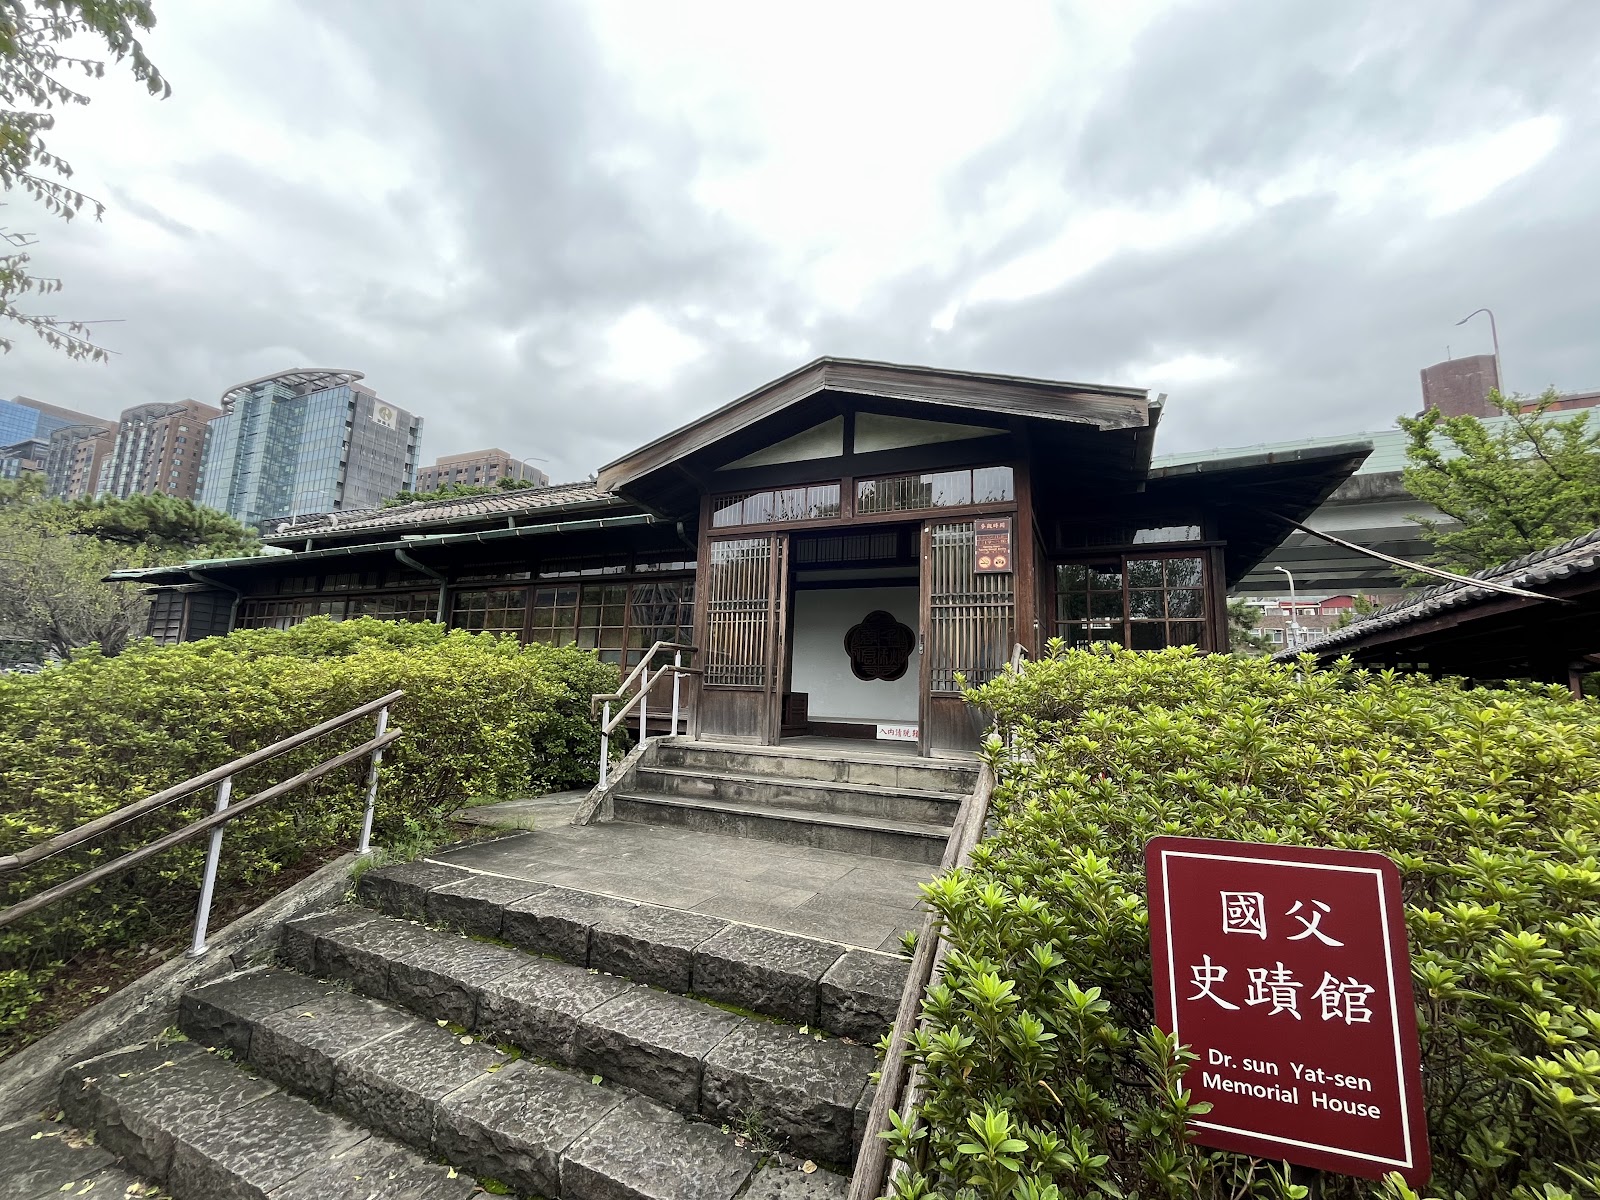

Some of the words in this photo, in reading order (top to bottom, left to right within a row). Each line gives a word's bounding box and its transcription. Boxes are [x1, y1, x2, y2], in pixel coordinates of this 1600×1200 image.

[1219, 890, 1345, 947] 國父
[1186, 953, 1376, 1026] 史蹟館
[1202, 1071, 1299, 1105] Memorial
[1311, 1090, 1381, 1119] House
[1208, 1048, 1237, 1069] Dr.
[1242, 1058, 1279, 1076] sun
[1289, 1061, 1372, 1092] Yat-sen
